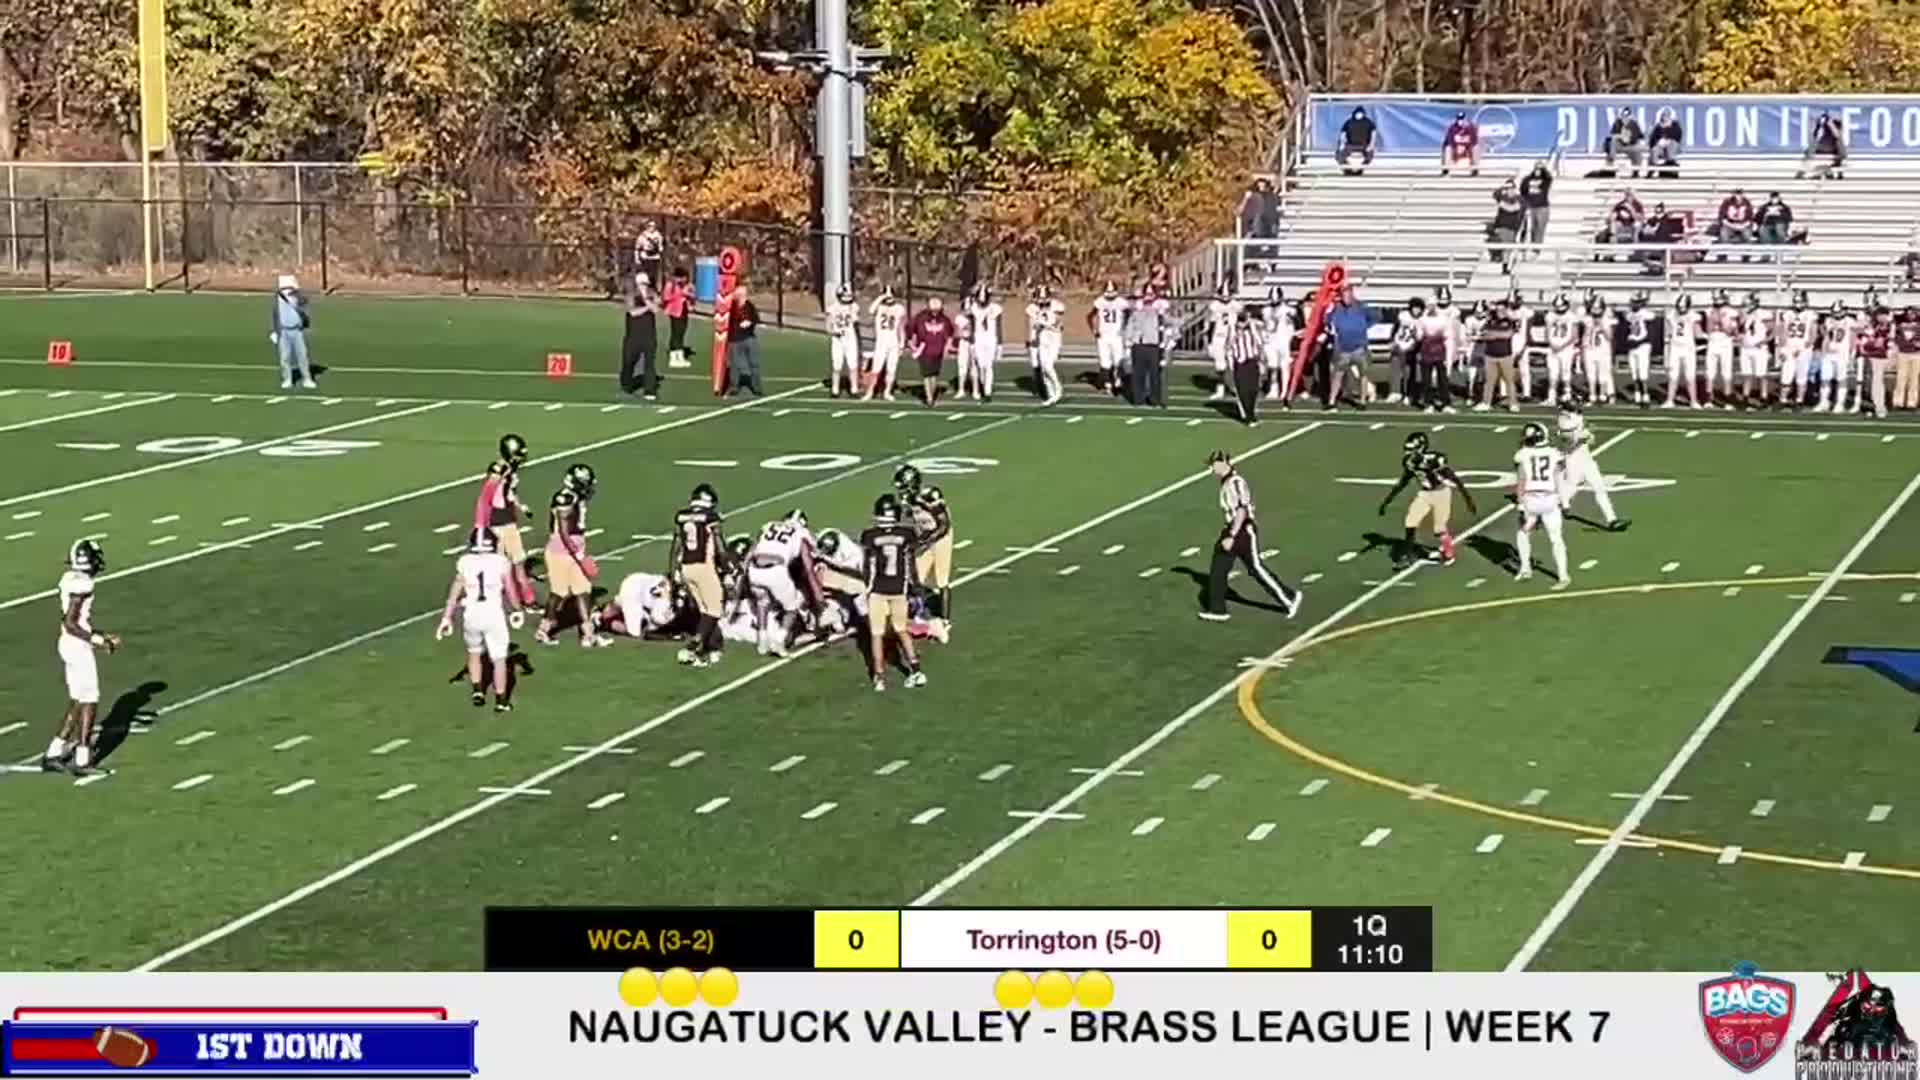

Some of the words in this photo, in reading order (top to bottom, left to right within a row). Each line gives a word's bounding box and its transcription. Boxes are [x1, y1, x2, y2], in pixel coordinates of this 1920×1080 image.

[1103, 308, 1117, 323] 21
[52, 344, 67, 361] 10
[1530, 454, 1551, 482] 12
[764, 522, 796, 545] 52
[477, 570, 487, 602] 1
